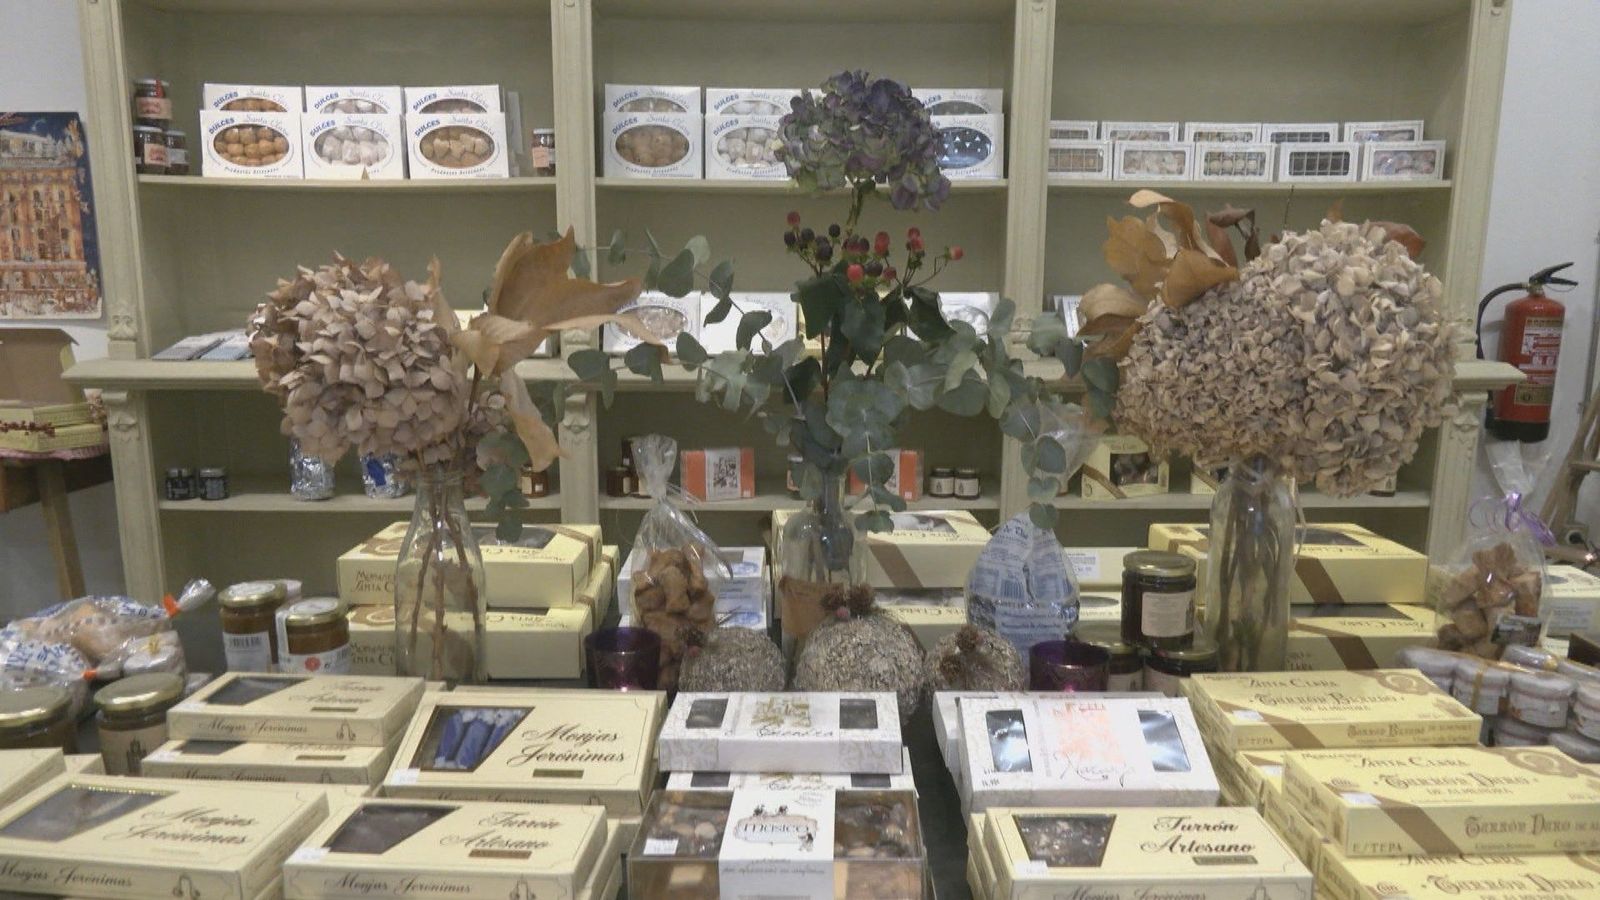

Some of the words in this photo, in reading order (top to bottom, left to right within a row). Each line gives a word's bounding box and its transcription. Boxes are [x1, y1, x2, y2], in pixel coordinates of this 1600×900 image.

[213, 91, 239, 108] DULCES
[314, 92, 339, 110] DULCES
[413, 92, 438, 111] DULCES
[612, 90, 638, 108] DULCES
[714, 93, 739, 111] DULCES
[209, 117, 235, 135] DULCES
[310, 119, 336, 137] DULCES
[415, 119, 440, 137] DULCES
[612, 117, 638, 135] DULCES
[713, 118, 739, 136] DULCES
[521, 722, 620, 748] Monjas
[505, 740, 626, 768] Jerónimas
[1153, 815, 1239, 833] Turrón
[1139, 833, 1256, 855] Artesano
[323, 871, 389, 893] Monjas
